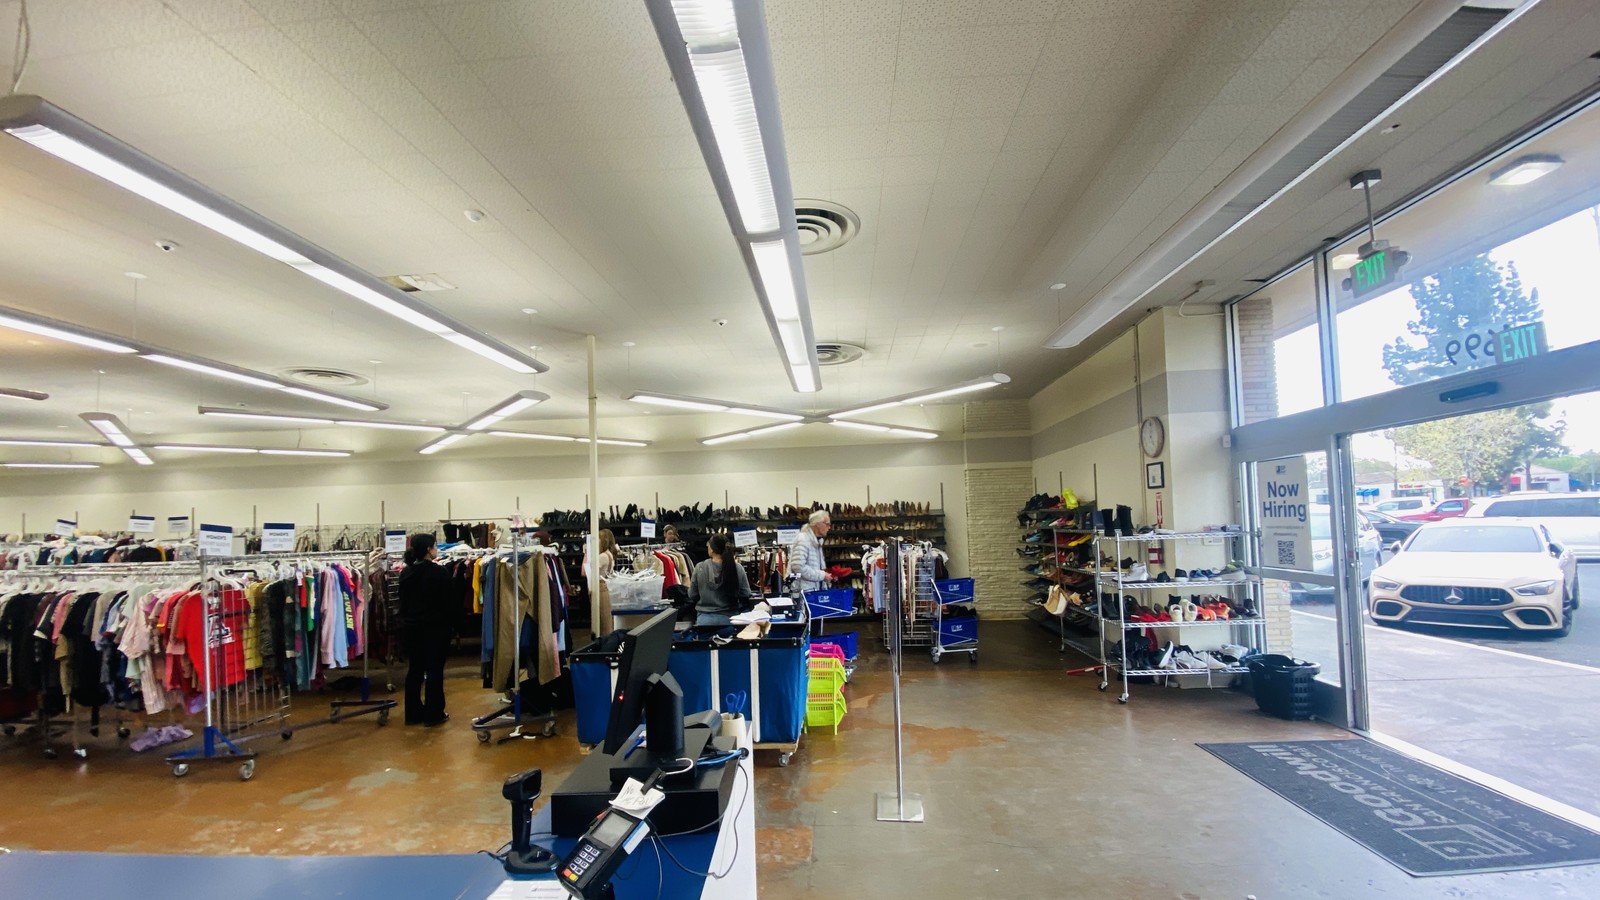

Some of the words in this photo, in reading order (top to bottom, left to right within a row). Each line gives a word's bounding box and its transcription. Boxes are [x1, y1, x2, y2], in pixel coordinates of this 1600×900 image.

[1355, 252, 1386, 290] EXIT
[1500, 325, 1537, 363] EXIT
[1267, 481, 1299, 498] Now
[1263, 501, 1307, 522] Hiring
[344, 601, 353, 612] DO
[346, 613, 354, 630] JUST
[1248, 744, 1426, 826] Goodwill
[1311, 757, 1412, 804] FRANCISCO
[1406, 804, 1456, 824] SAN
